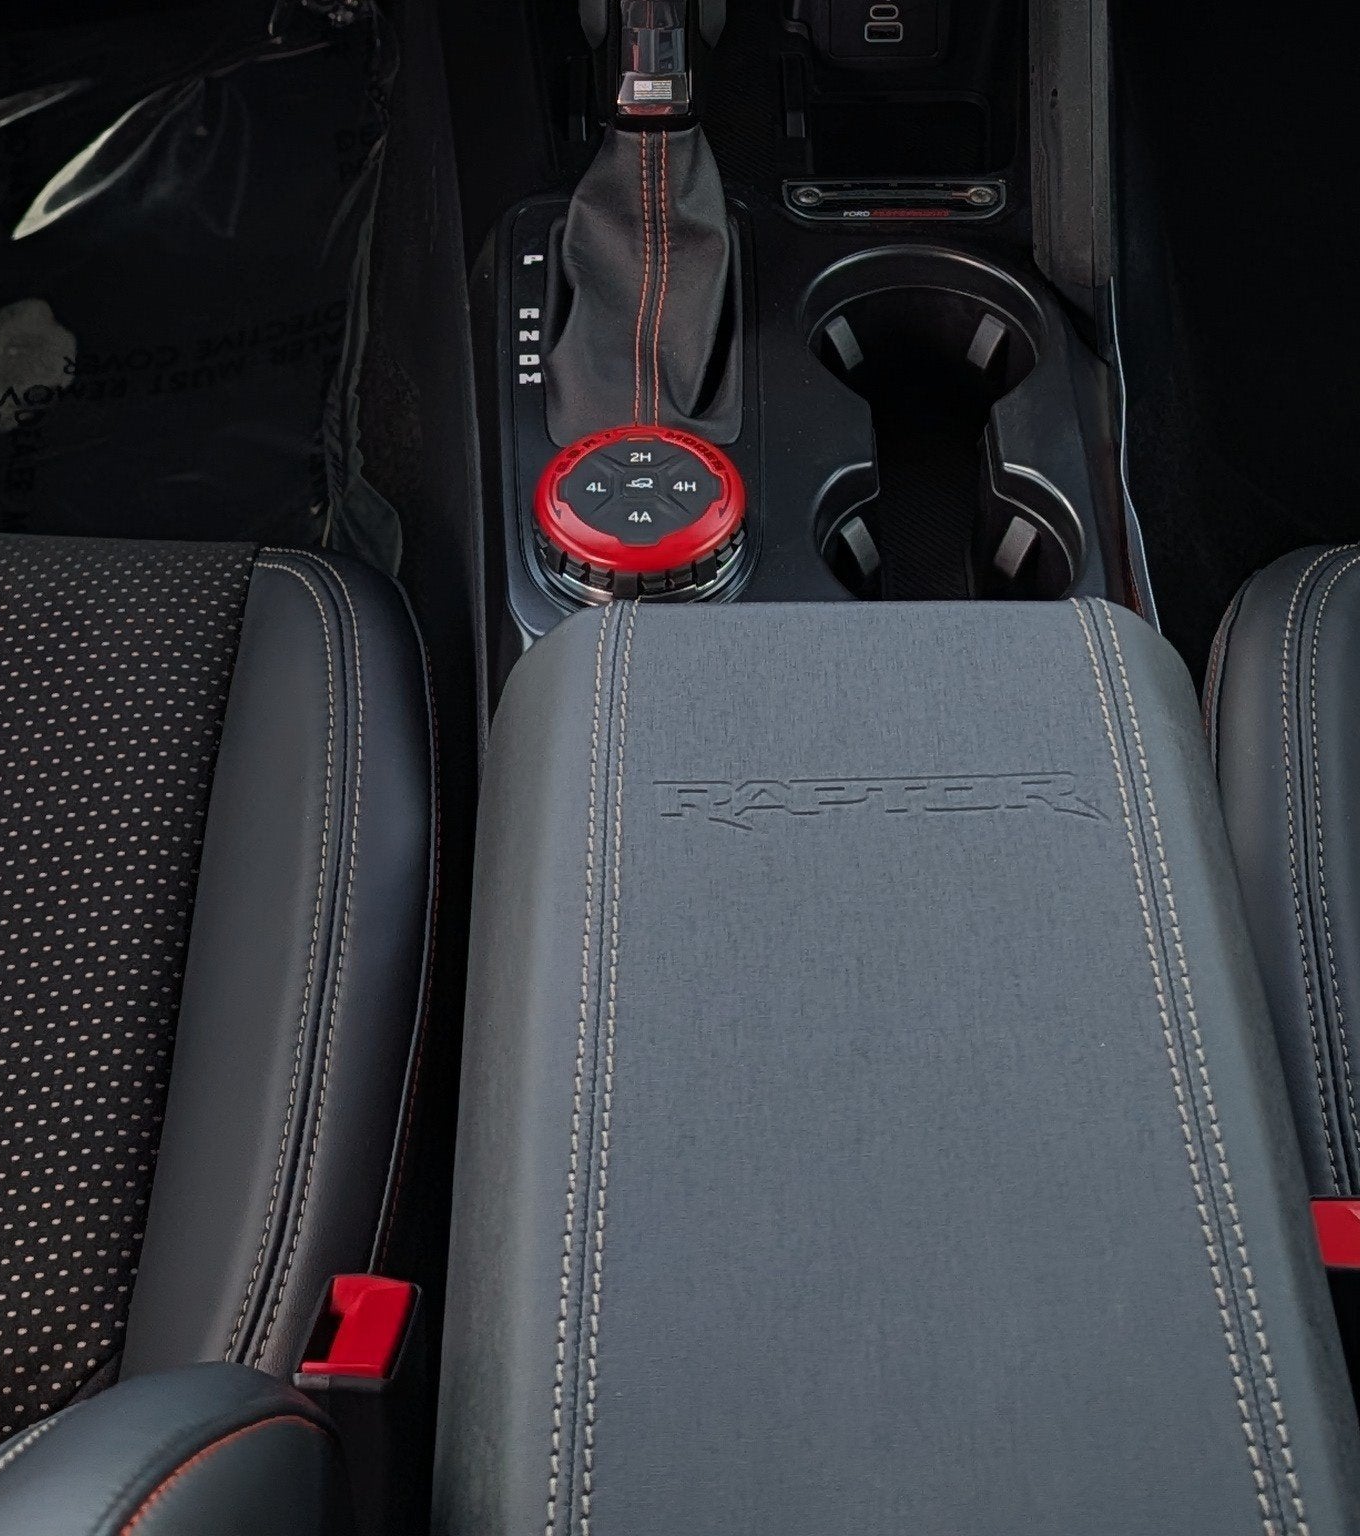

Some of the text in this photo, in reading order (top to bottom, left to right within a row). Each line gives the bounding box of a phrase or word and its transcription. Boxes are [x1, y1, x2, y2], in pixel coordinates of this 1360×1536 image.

[523, 254, 544, 266] P
[519, 330, 540, 342] N
[519, 373, 542, 384] M
[630, 451, 652, 463] 2H
[585, 481, 607, 492] 4L
[672, 480, 697, 492] 4H
[627, 510, 652, 524] 4A
